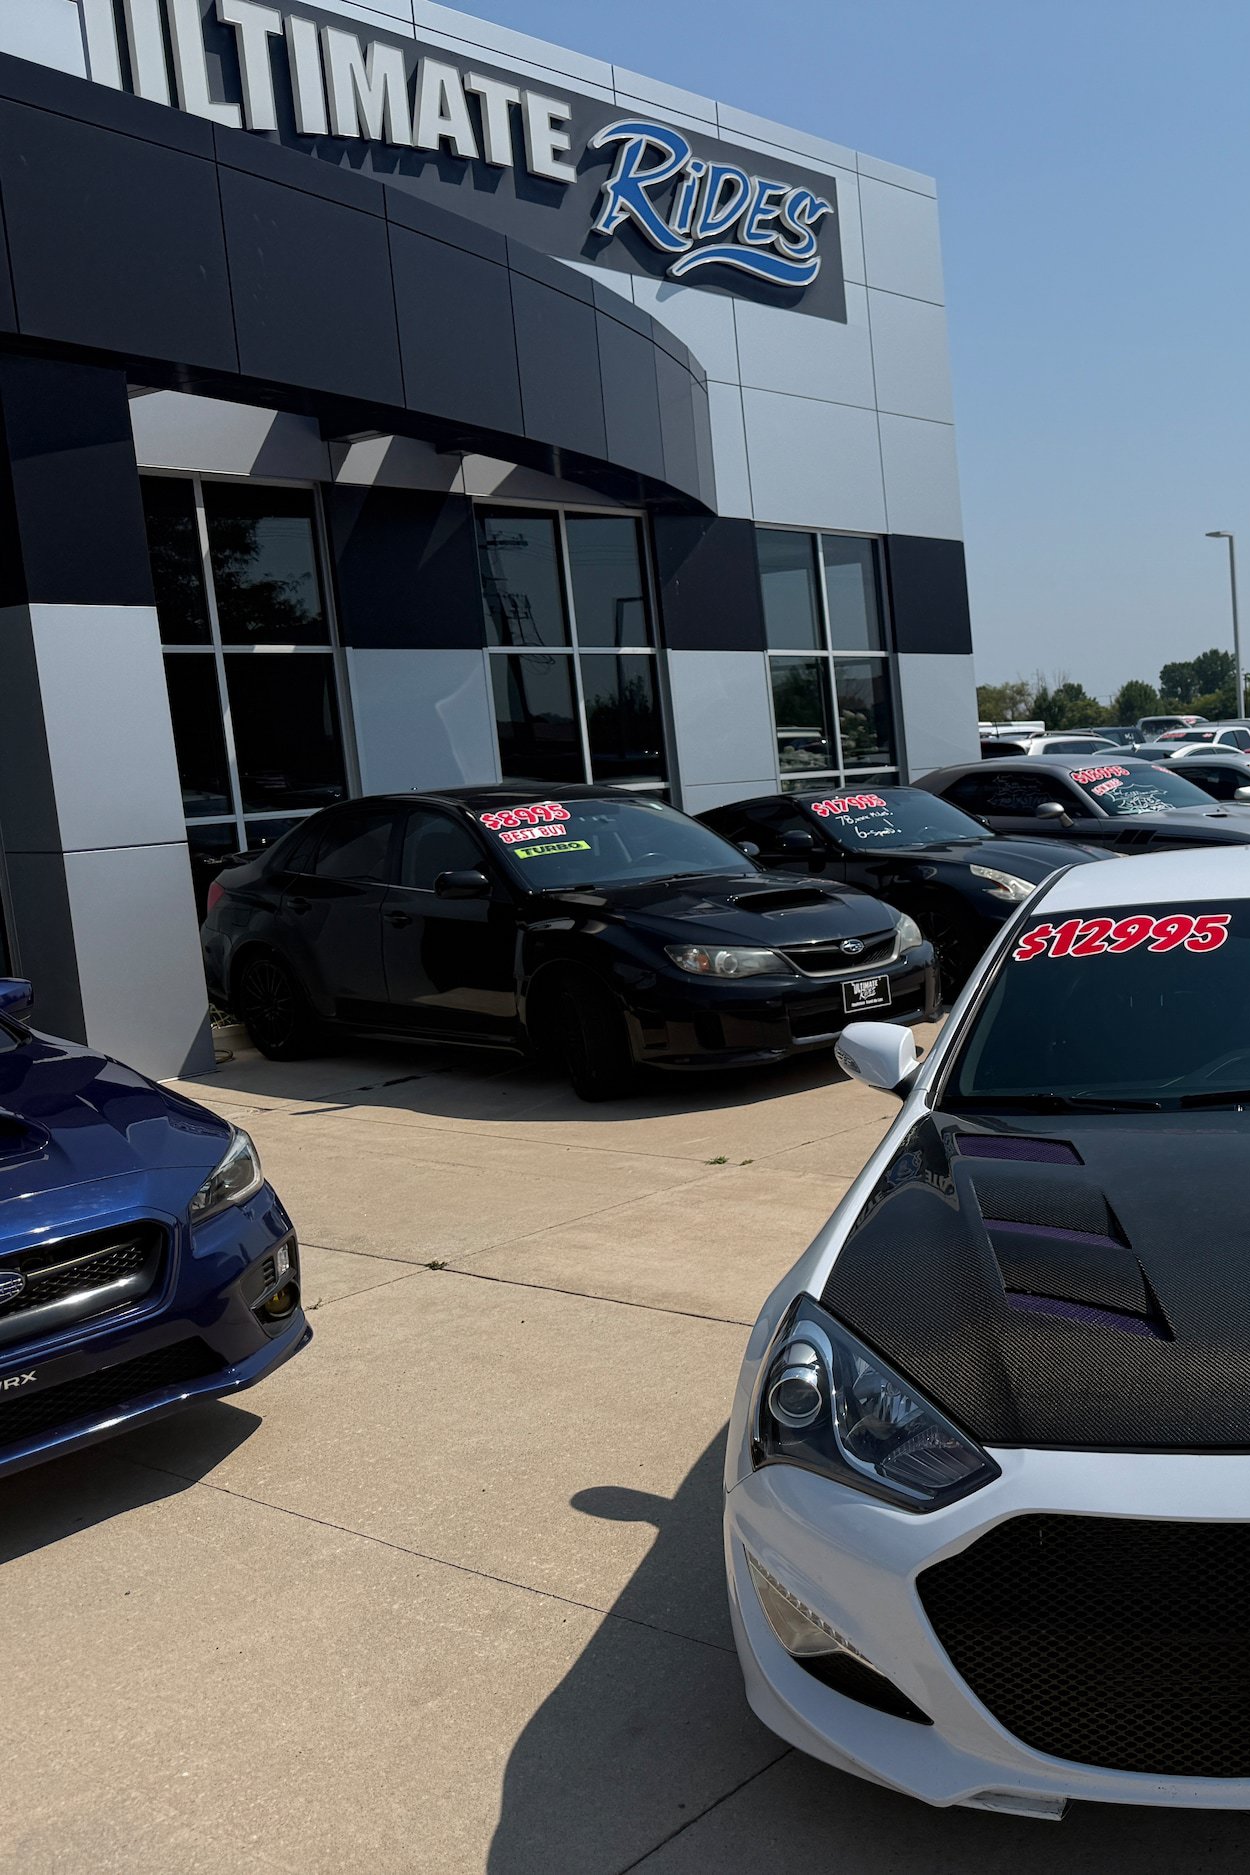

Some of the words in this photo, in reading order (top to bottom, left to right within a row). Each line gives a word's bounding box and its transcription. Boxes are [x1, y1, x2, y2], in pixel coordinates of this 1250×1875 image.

[811, 794, 886, 817] $17995
[480, 804, 570, 830] $8995
[499, 828, 537, 844] BEST
[537, 824, 567, 838] BUY
[520, 842, 582, 857] TURBO
[1013, 914, 1232, 961] $12995
[0, 1370, 38, 1391] RX
